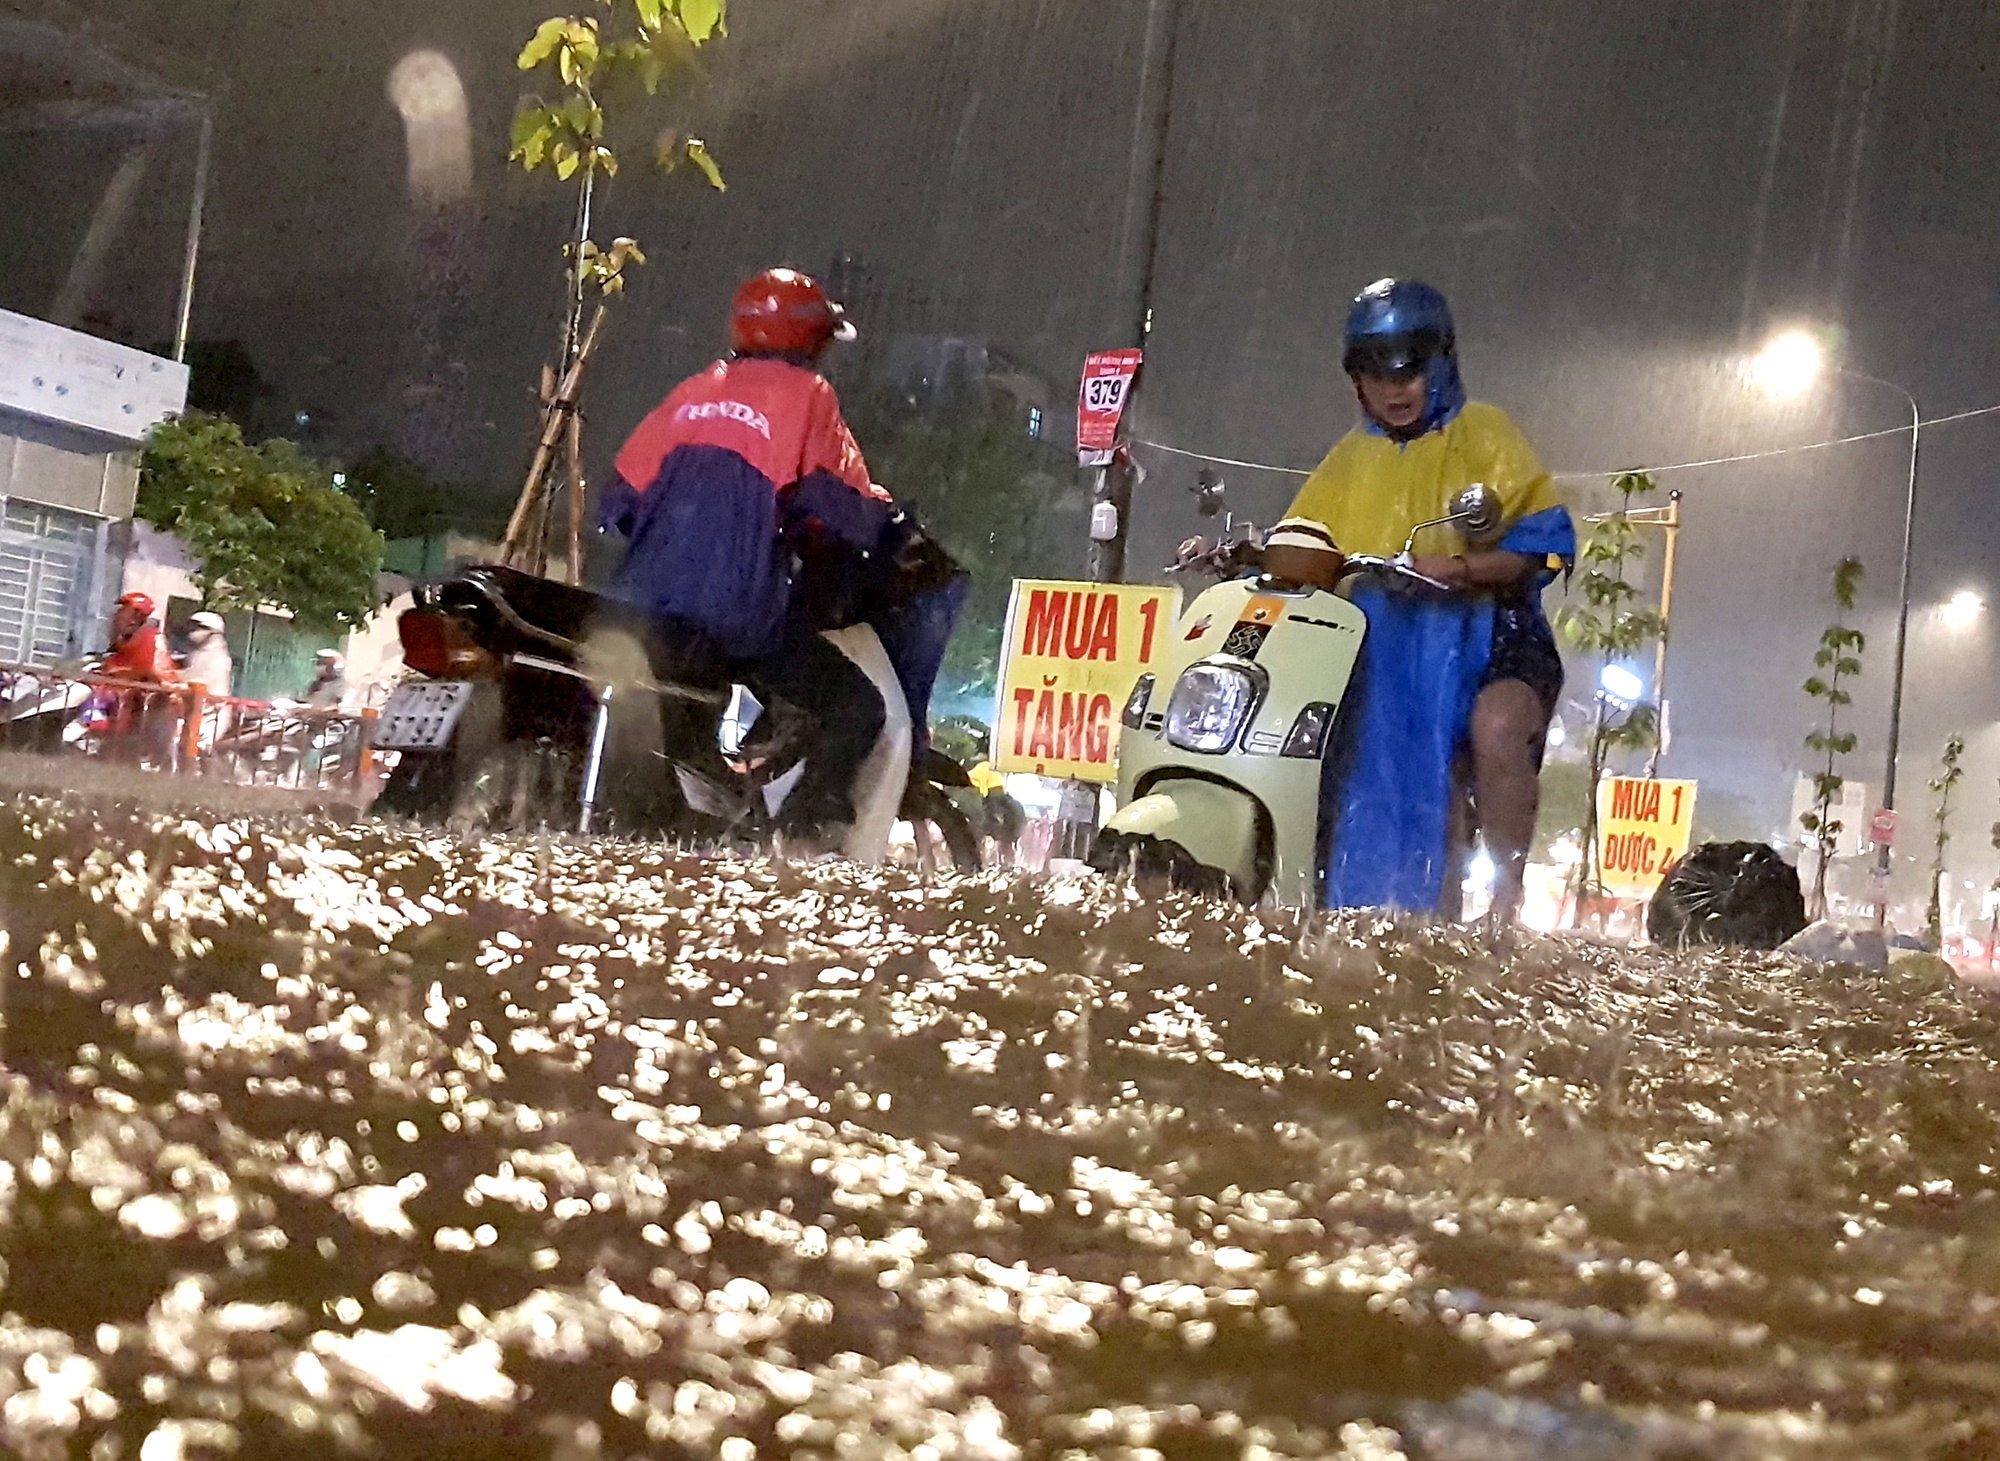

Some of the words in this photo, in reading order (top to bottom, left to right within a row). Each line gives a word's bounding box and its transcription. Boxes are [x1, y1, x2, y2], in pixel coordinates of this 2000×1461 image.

[1089, 380, 1122, 405] 379
[1022, 590, 1119, 662] MUA
[1138, 597, 1159, 664] 1
[1611, 779, 1661, 823] MUA
[1671, 785, 1683, 826] 1
